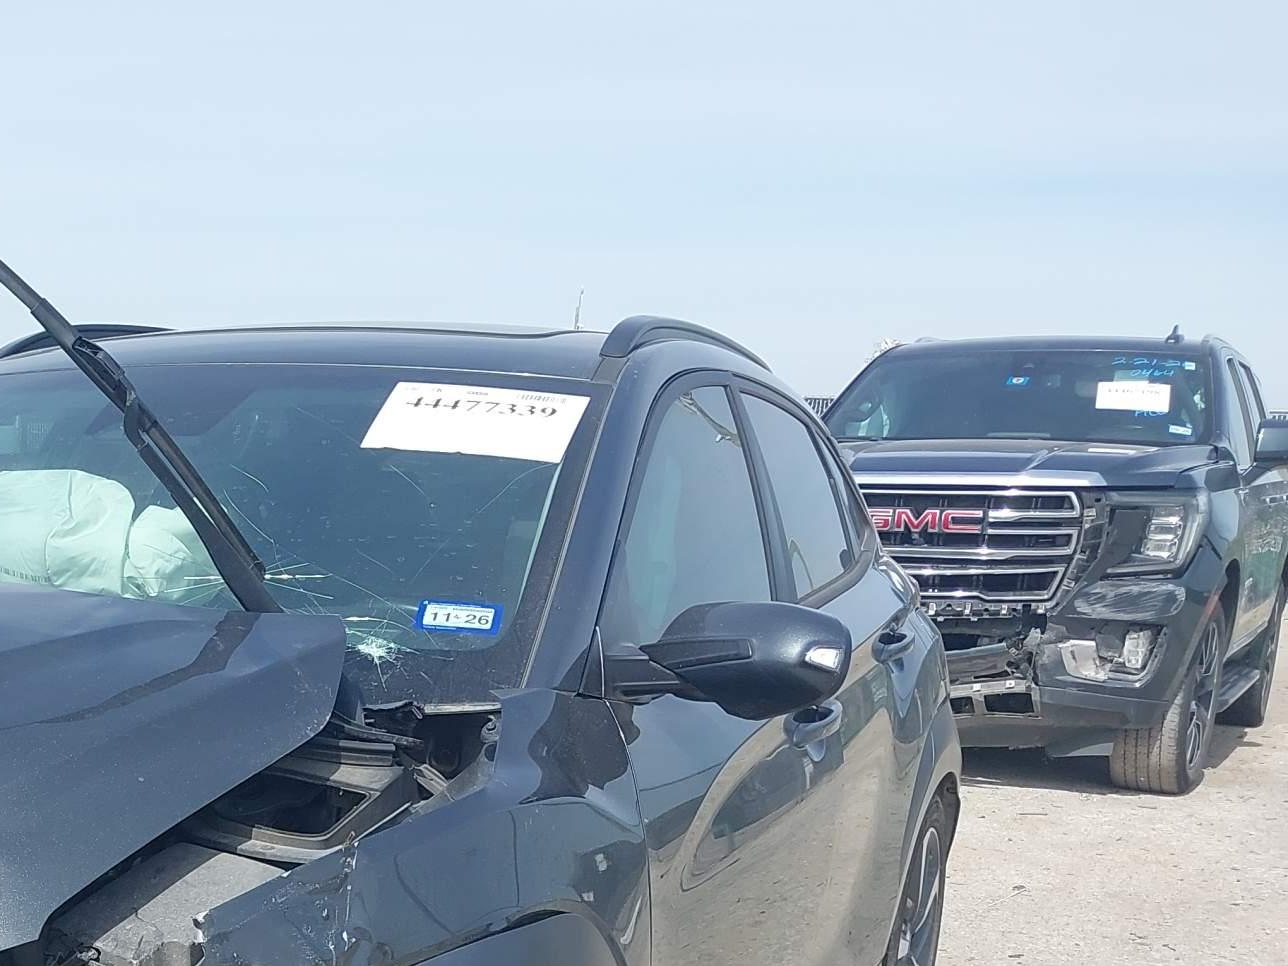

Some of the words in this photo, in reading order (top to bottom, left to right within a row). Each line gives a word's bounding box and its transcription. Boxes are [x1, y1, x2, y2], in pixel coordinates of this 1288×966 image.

[406, 396, 558, 418] 44477339
[868, 507, 984, 535] GMC
[430, 611, 452, 623] 11
[463, 613, 491, 626] 26
